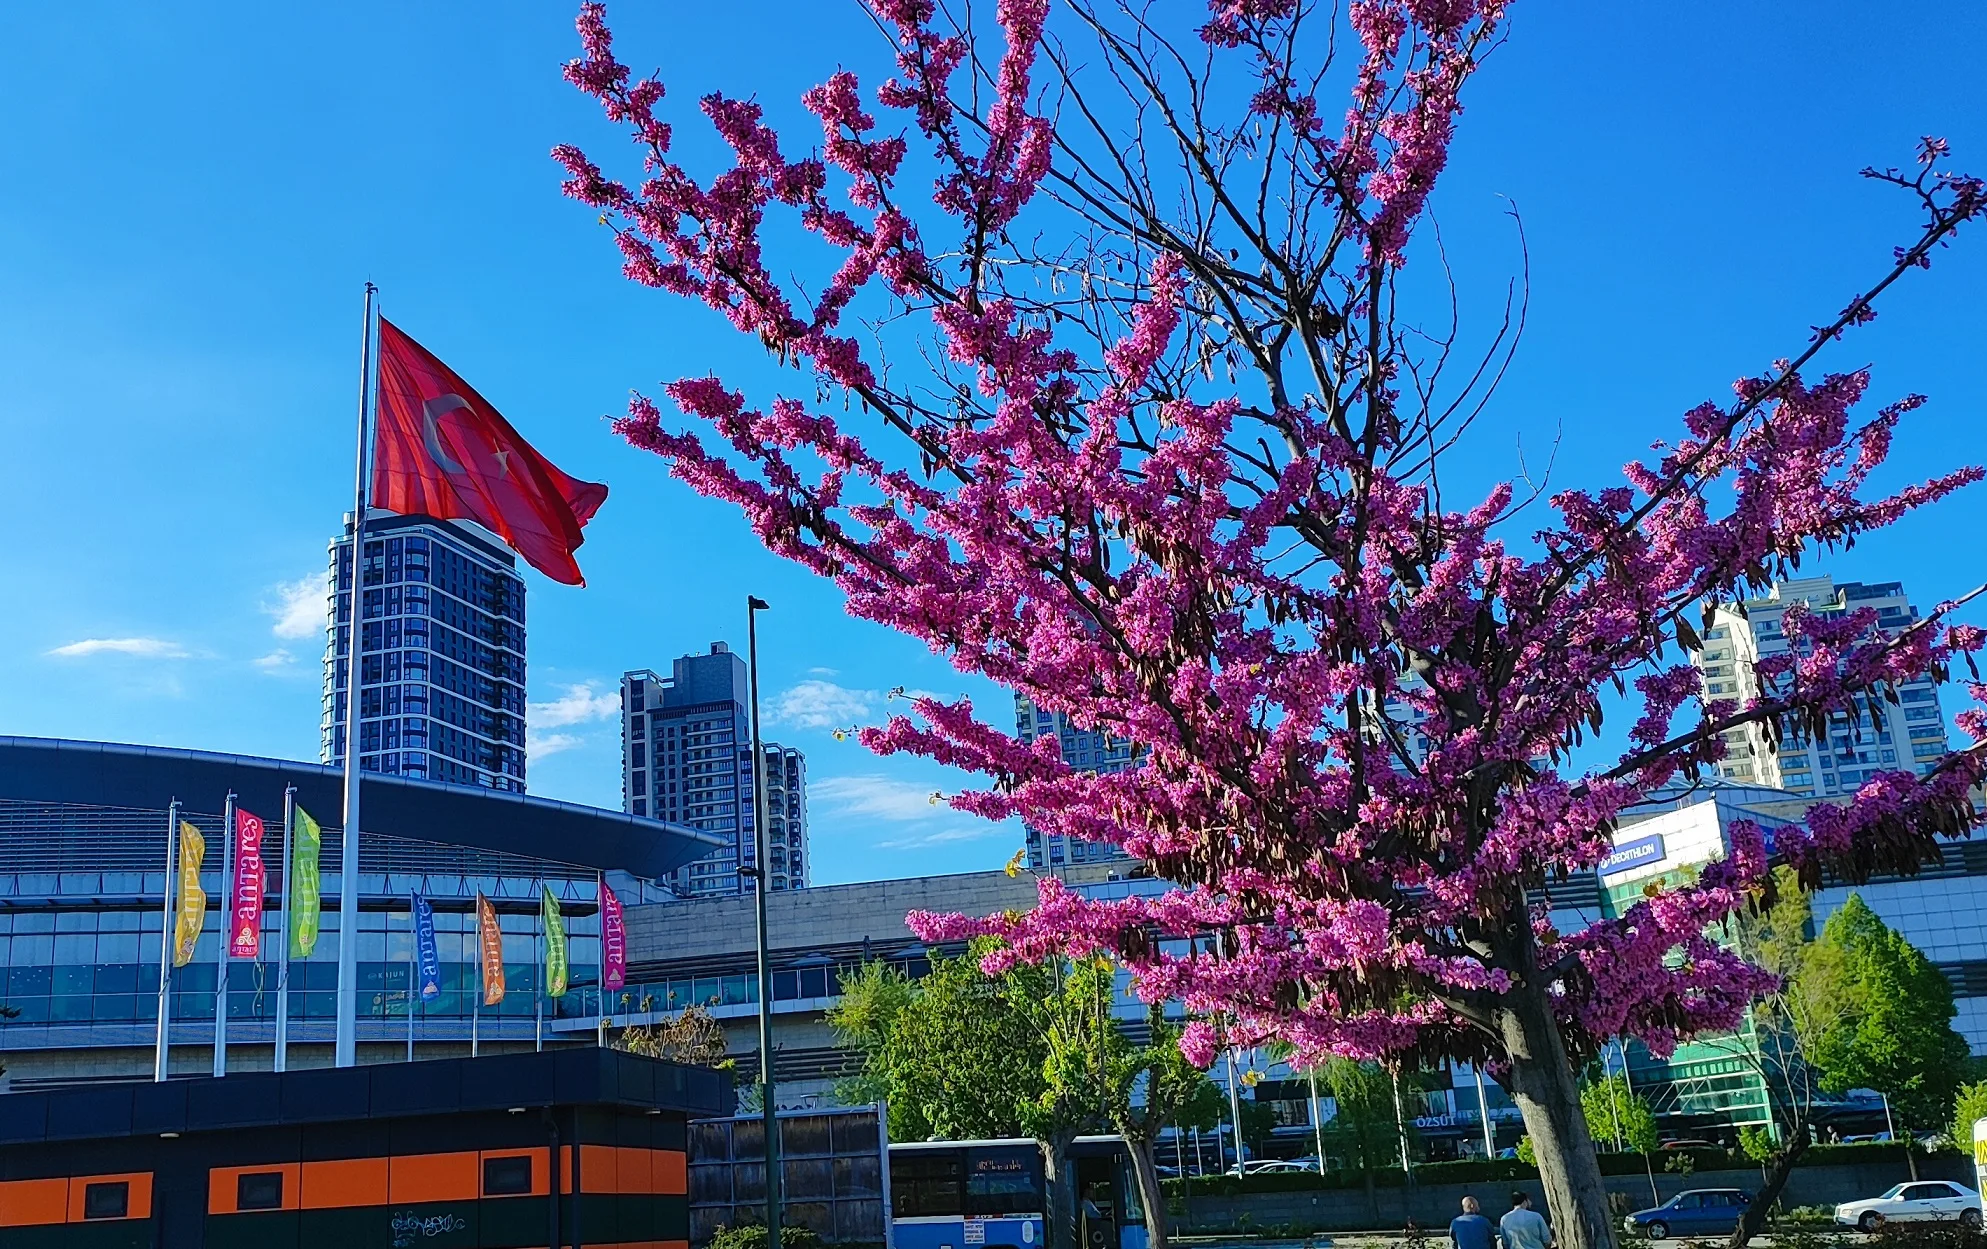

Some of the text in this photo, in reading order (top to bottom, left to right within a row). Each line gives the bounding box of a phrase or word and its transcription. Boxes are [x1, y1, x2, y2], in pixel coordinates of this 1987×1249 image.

[1611, 843, 1656, 866] DECATHLON
[238, 817, 260, 920] antares
[1416, 1114, 1456, 1128] ÖZSÜT
